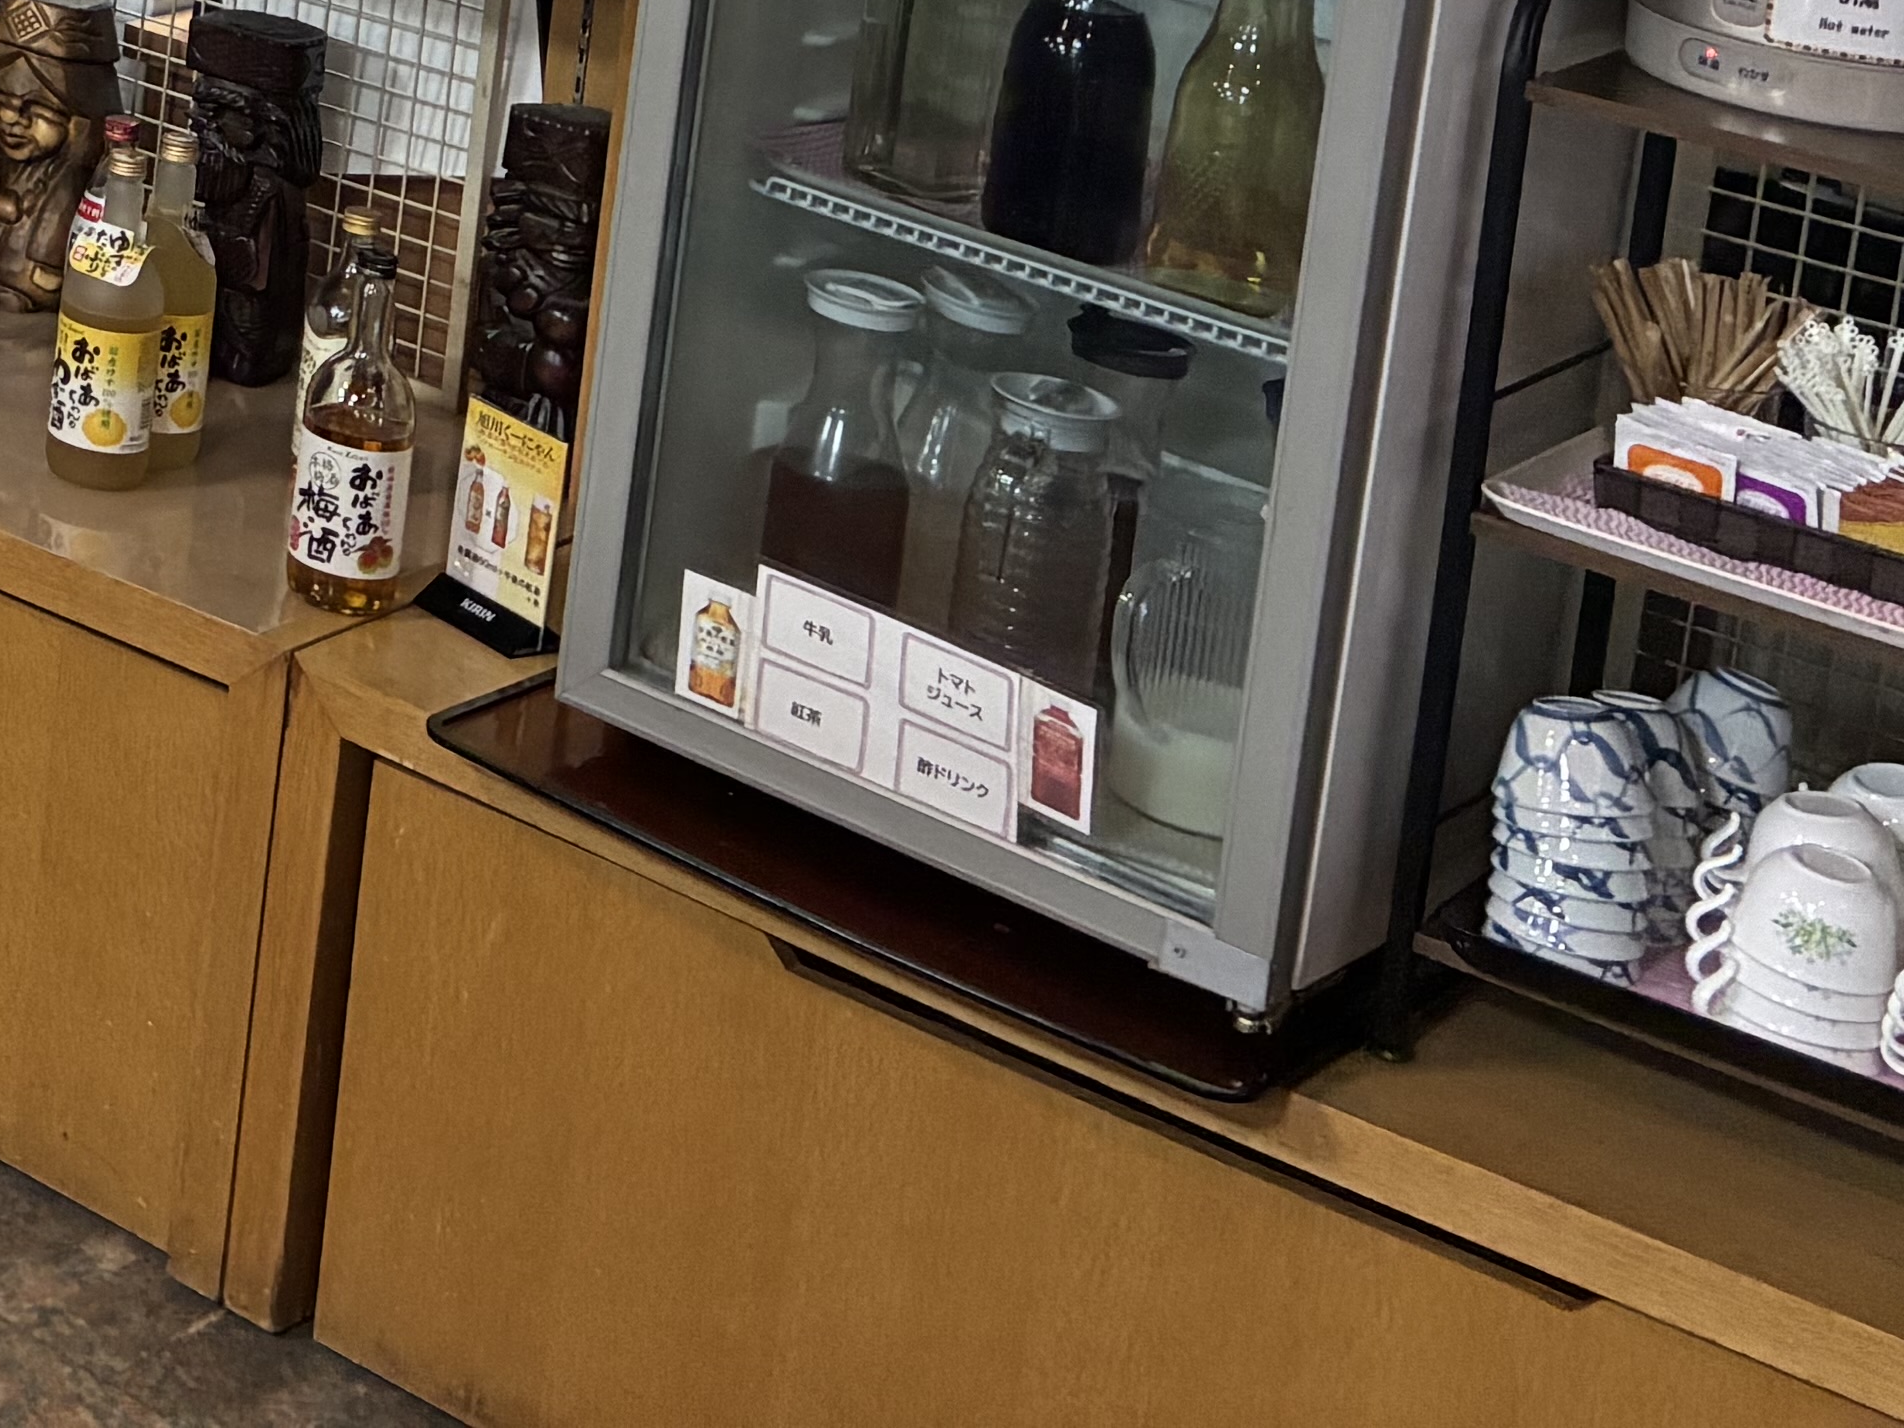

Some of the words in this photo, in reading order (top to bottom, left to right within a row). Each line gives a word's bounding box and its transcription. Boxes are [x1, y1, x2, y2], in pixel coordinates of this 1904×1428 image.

[1818, 17, 1843, 33] Hot
[1850, 21, 1891, 39] water
[296, 479, 342, 564] 梅酒
[460, 597, 496, 624] KIRIN
[803, 619, 834, 646] 牛乳
[936, 666, 976, 696] トマト
[790, 700, 823, 728] 紅茶
[926, 684, 983, 722] ジュース
[916, 756, 990, 799] 酢ドリンク
